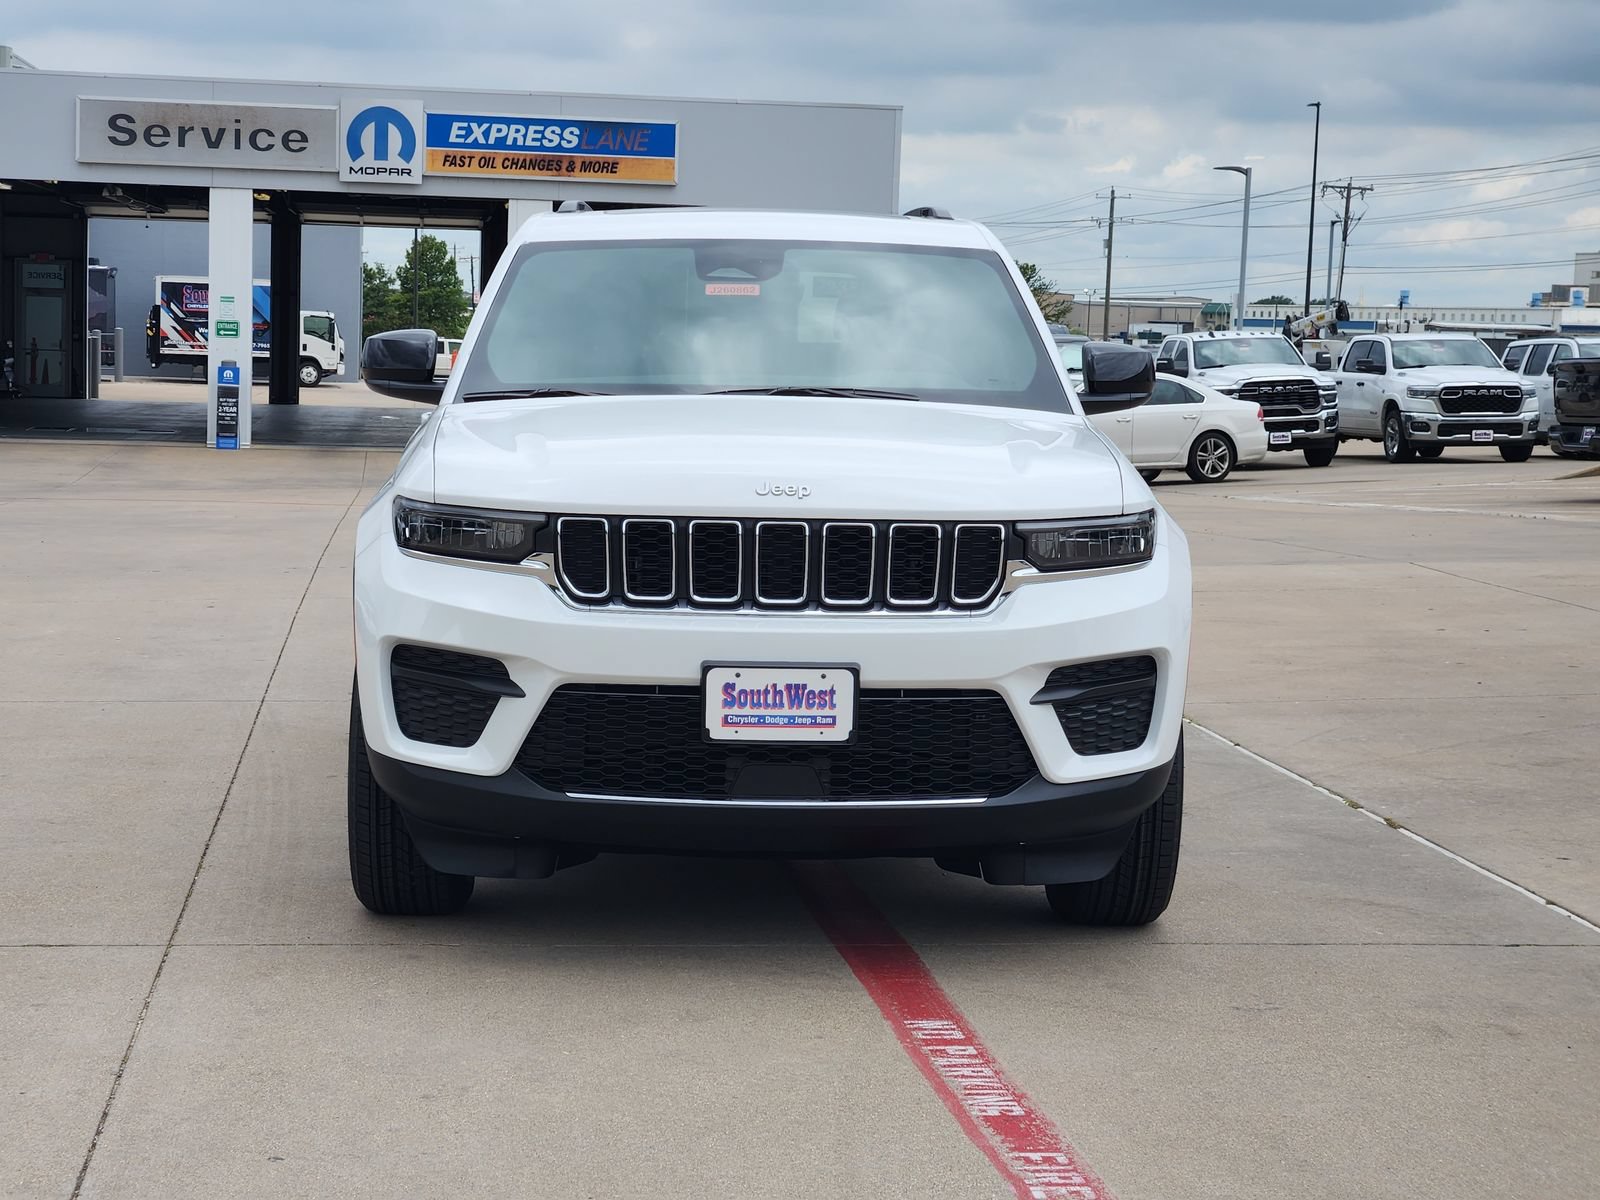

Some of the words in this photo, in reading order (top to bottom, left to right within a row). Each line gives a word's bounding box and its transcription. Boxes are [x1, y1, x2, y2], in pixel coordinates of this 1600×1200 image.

[107, 113, 309, 153] Service
[349, 166, 413, 177] MOPAR
[442, 155, 475, 168] FAST
[478, 156, 497, 170] OIL
[501, 157, 563, 172] CHANGES
[568, 160, 576, 173] &
[579, 161, 619, 174] MORE
[1260, 385, 1300, 393] RAM
[755, 480, 811, 499] Jeep
[721, 682, 837, 711] SouthWest
[727, 715, 758, 724] Chrysler
[765, 716, 789, 725] Dodge
[794, 716, 812, 725] Jeep
[816, 716, 833, 724] Ram
[904, 1019, 965, 1040] NO
[920, 1045, 1025, 1116] PARKING
